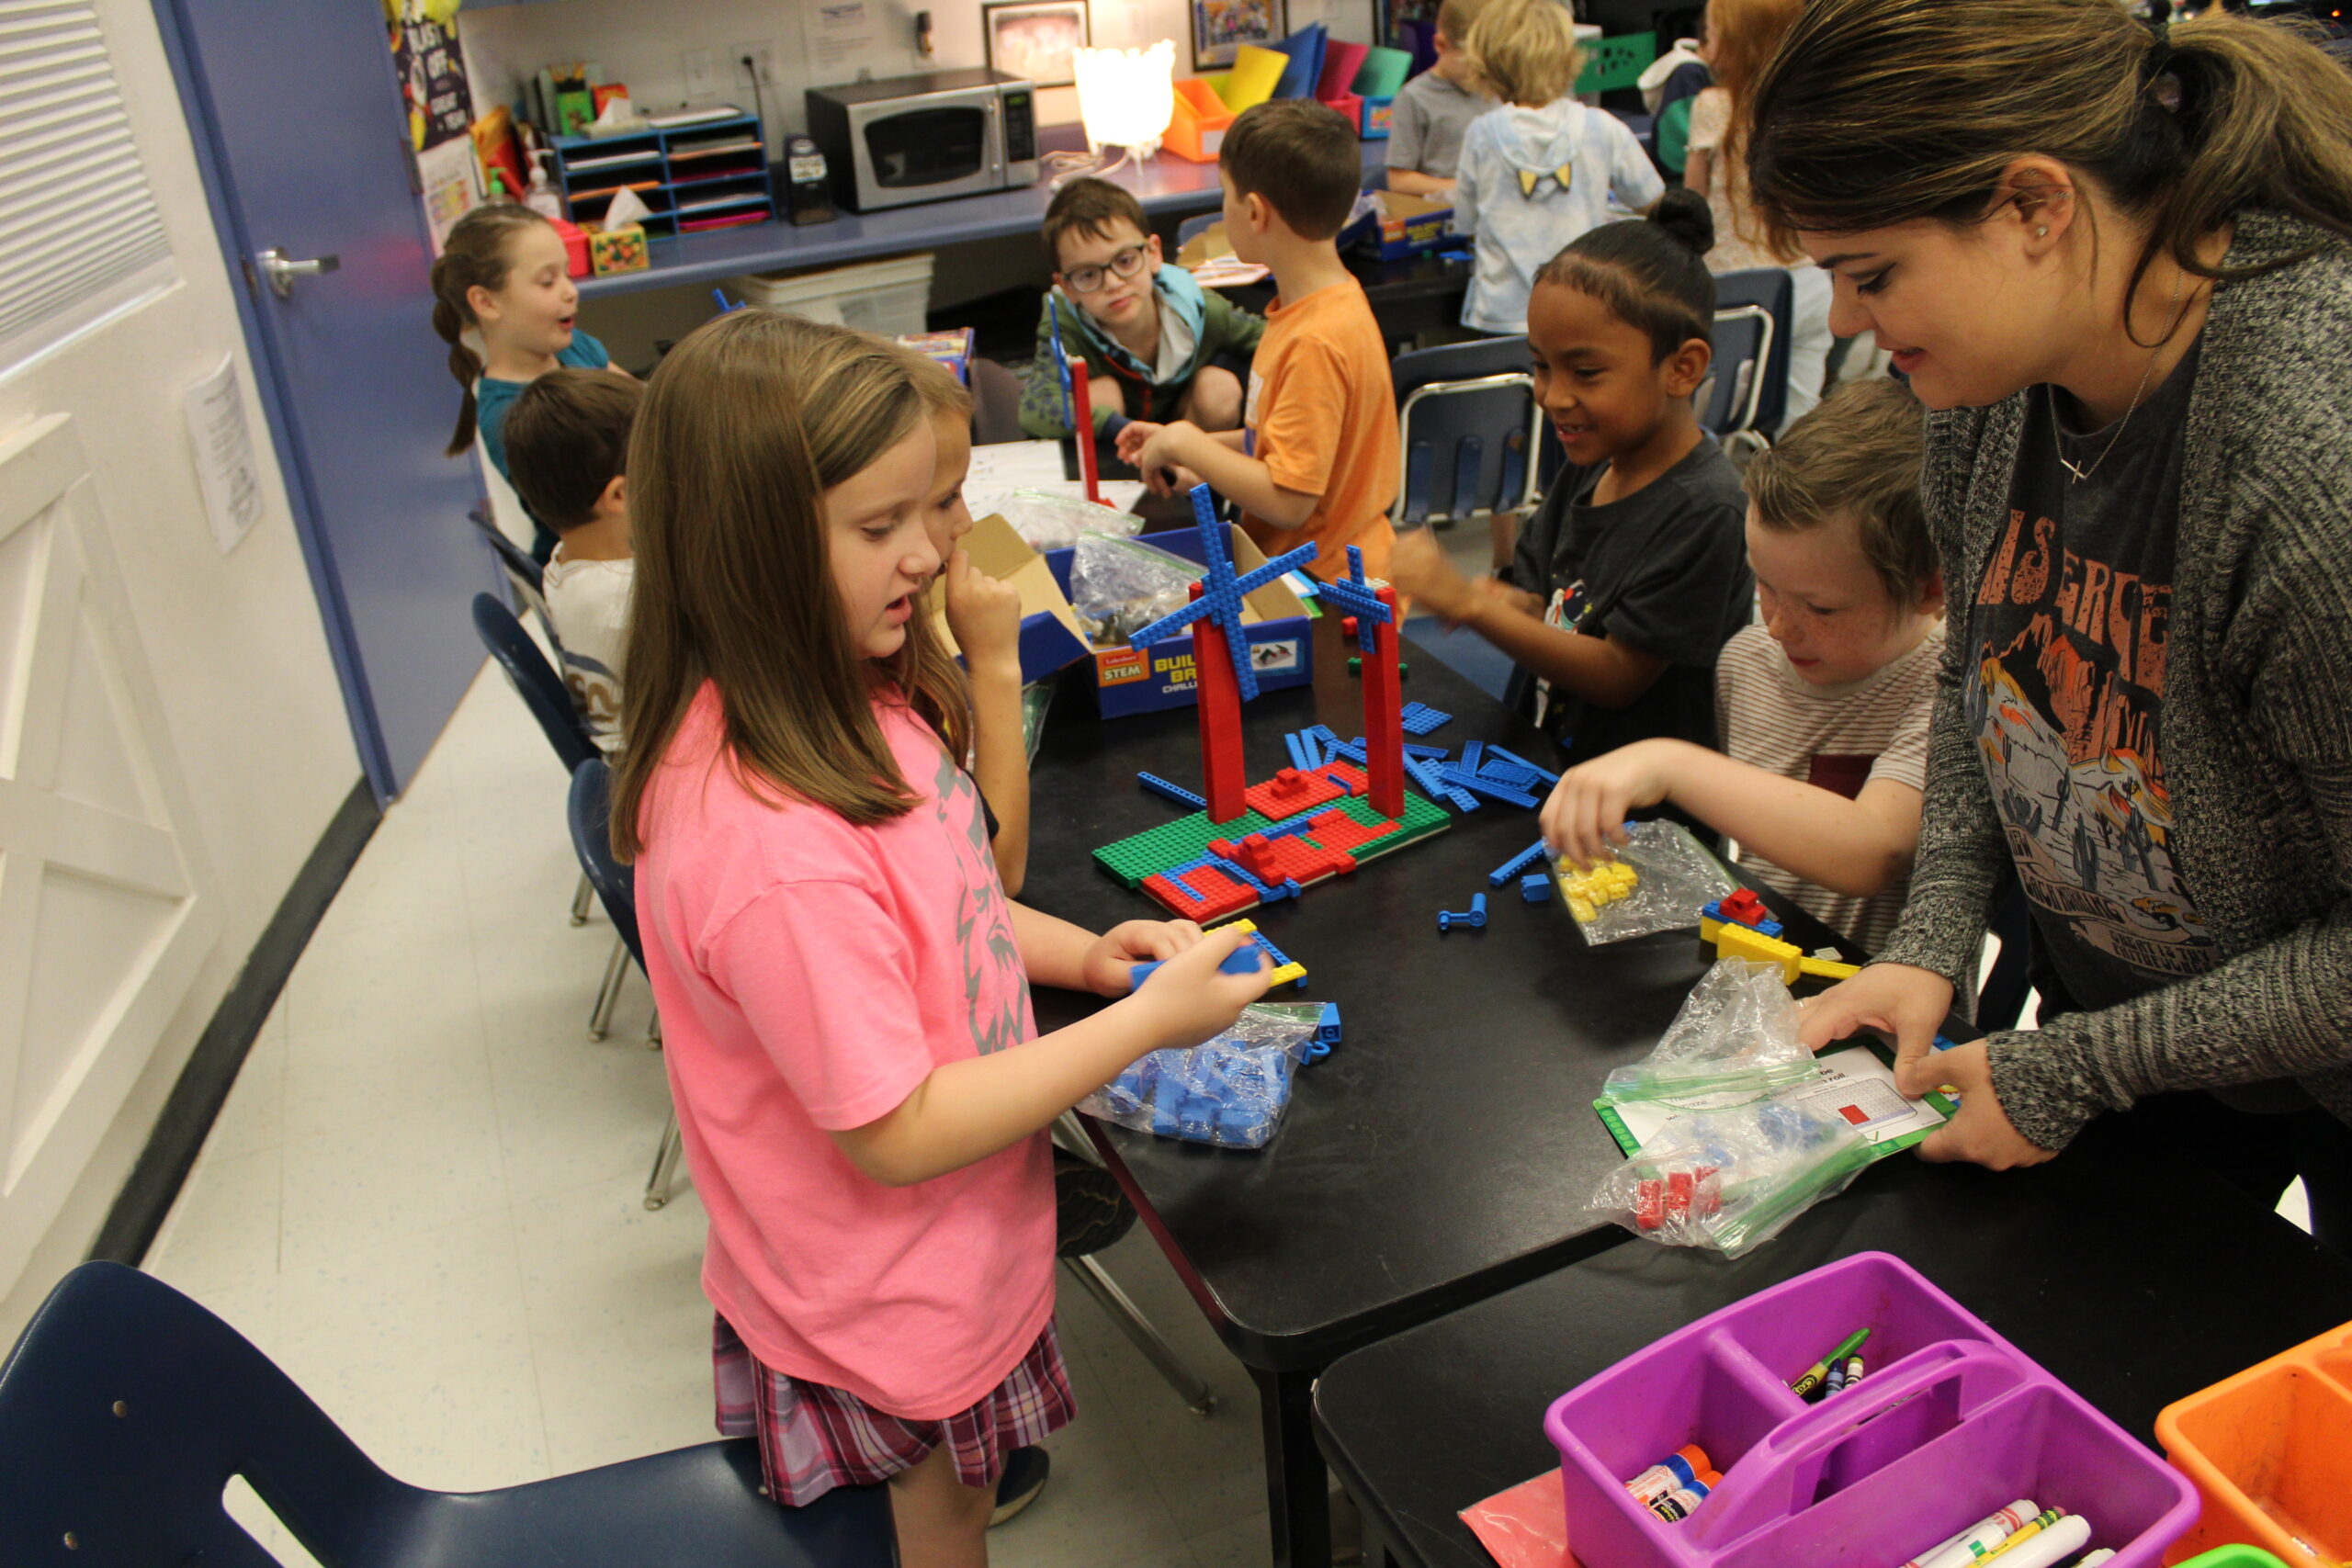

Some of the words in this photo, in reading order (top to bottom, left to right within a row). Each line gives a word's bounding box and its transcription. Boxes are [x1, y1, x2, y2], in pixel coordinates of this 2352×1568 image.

[1976, 508, 2056, 606] IS
[1154, 654, 1196, 673] BUIL
[1104, 665, 1141, 681] STEM
[1162, 682, 1198, 694] CHALL
